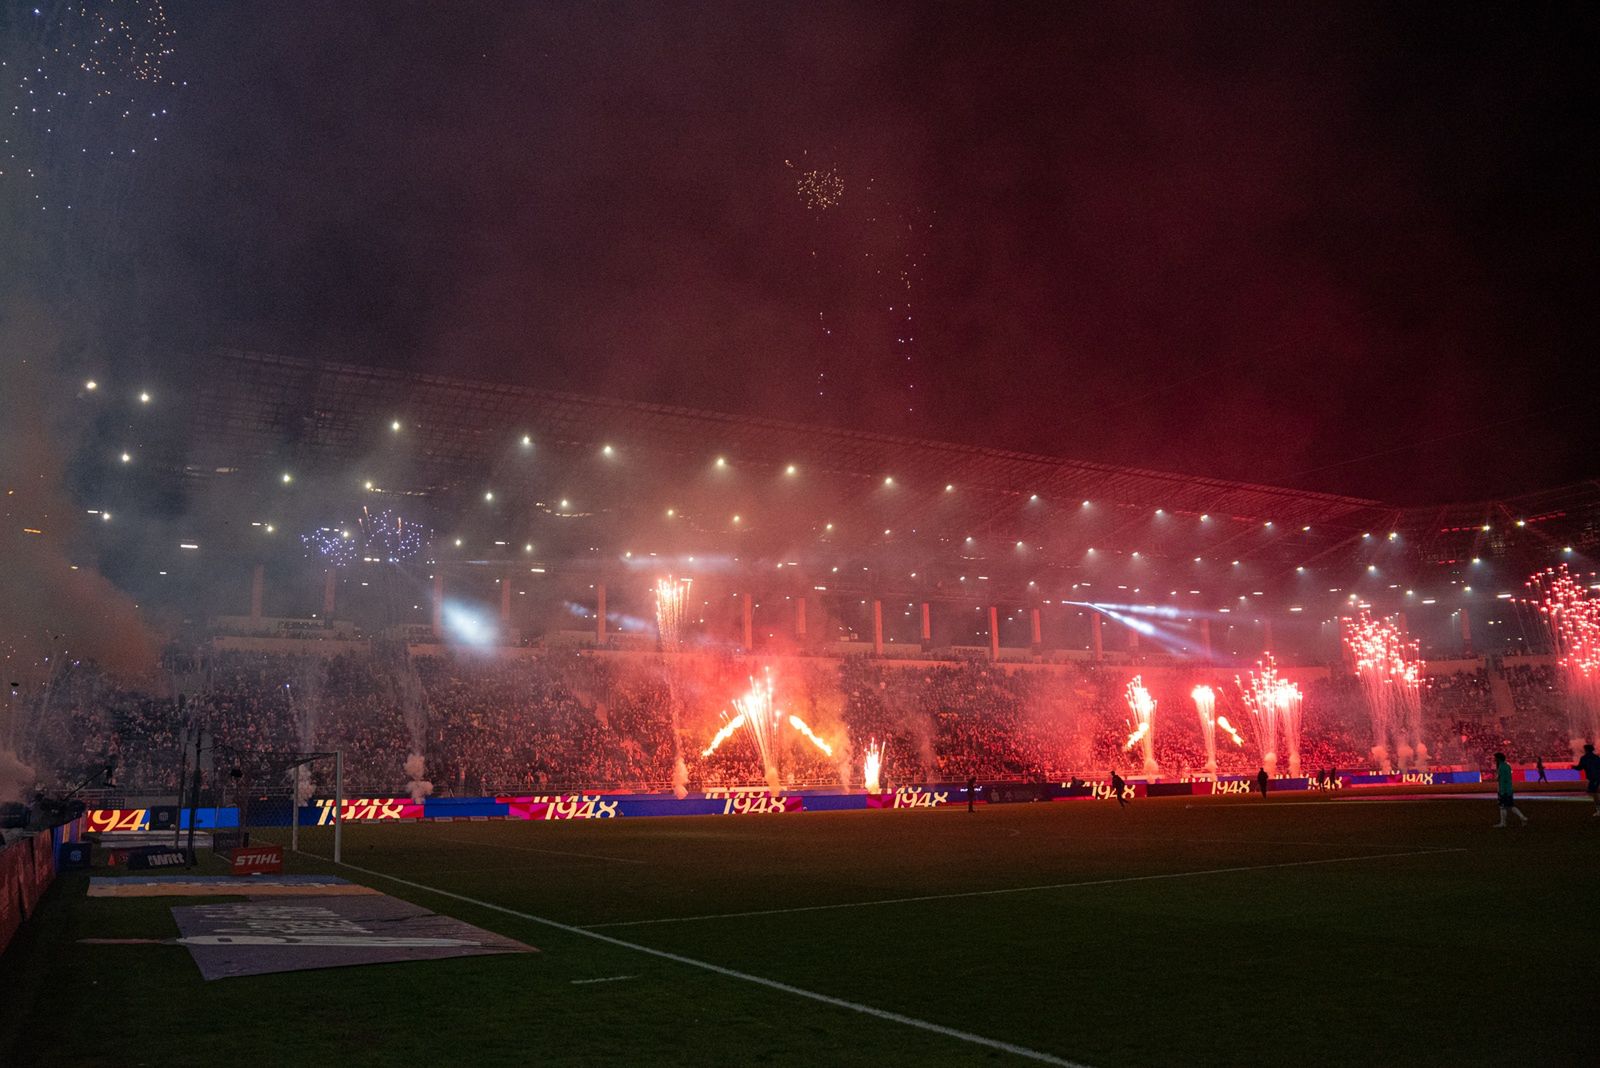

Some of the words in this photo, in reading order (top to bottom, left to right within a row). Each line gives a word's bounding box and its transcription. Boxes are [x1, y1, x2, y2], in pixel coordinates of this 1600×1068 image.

[1211, 780, 1251, 795] 1948
[723, 797, 787, 815] 1948
[893, 792, 948, 809] 1948
[545, 801, 618, 820] 1948
[87, 809, 150, 832] 94
[234, 853, 281, 867] STIHL
